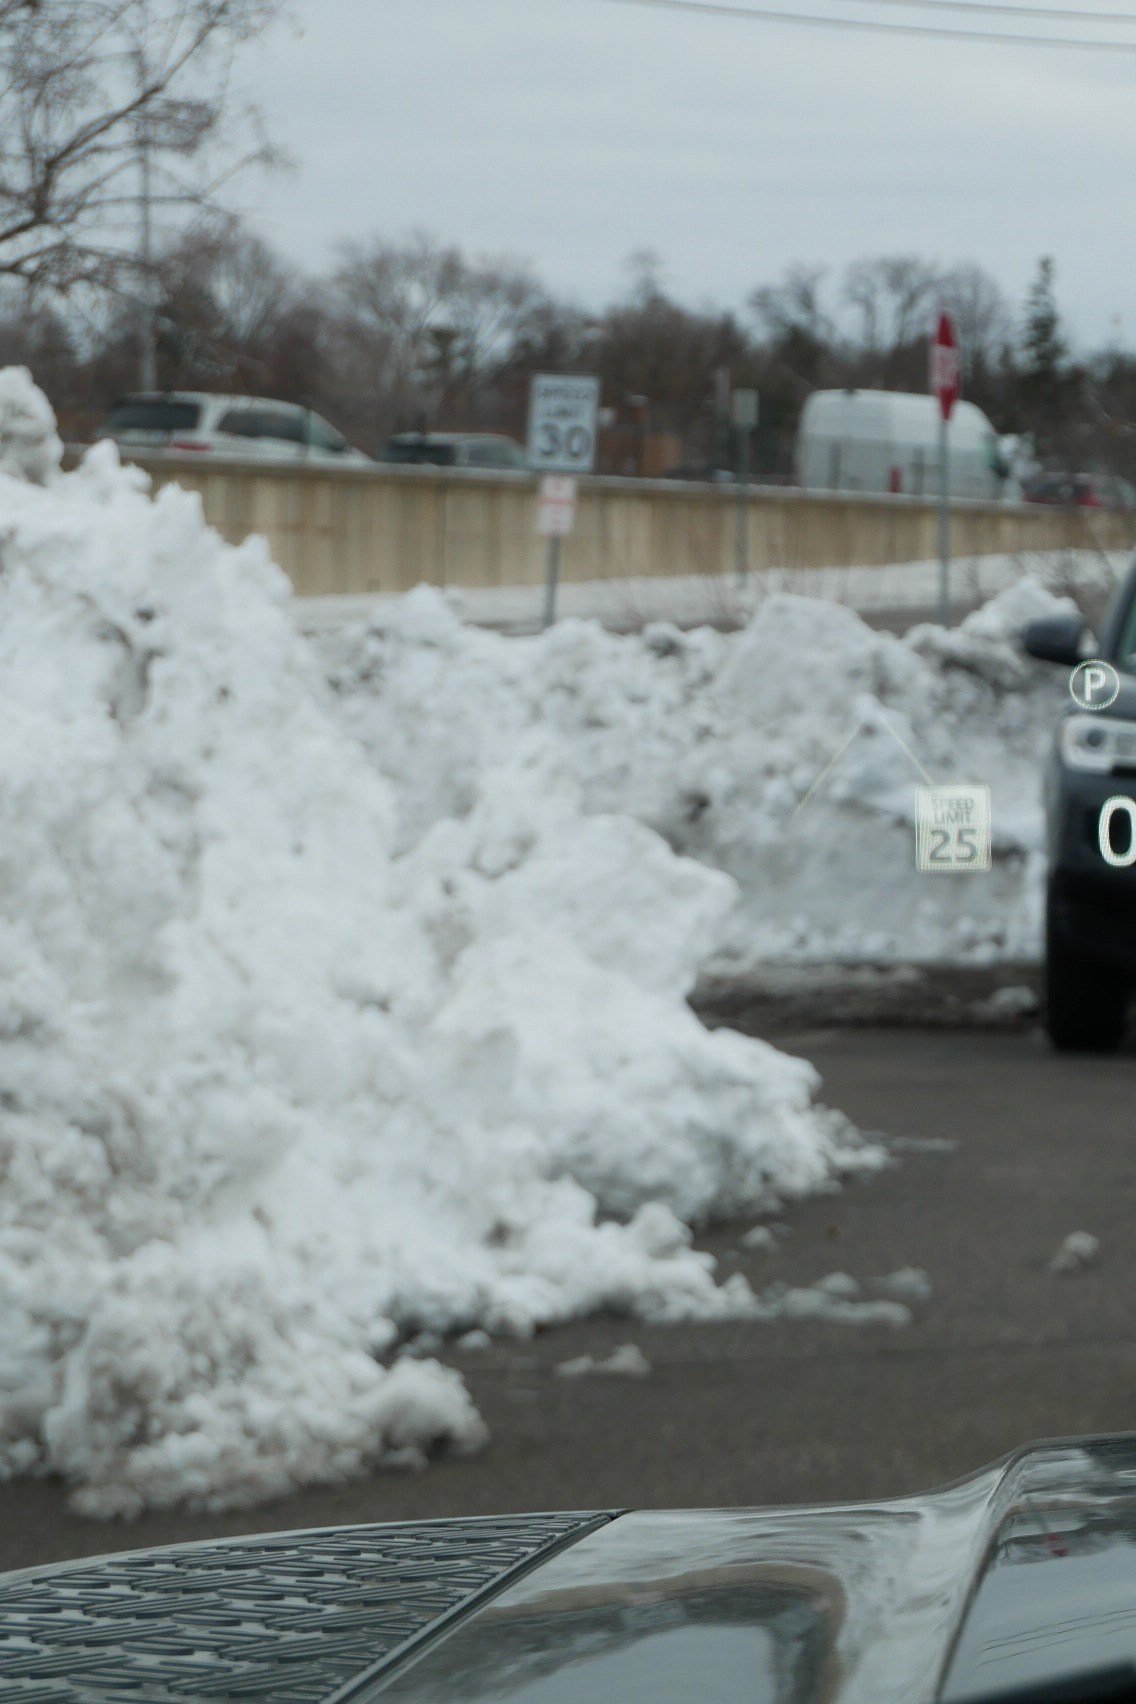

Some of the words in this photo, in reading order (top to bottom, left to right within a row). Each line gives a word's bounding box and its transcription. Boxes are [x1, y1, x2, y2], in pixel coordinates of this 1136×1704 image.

[539, 422, 591, 457] 30
[1085, 668, 1106, 701] P
[932, 797, 975, 810] SPEED
[934, 810, 972, 824] LIMIT
[929, 828, 978, 863] 25
